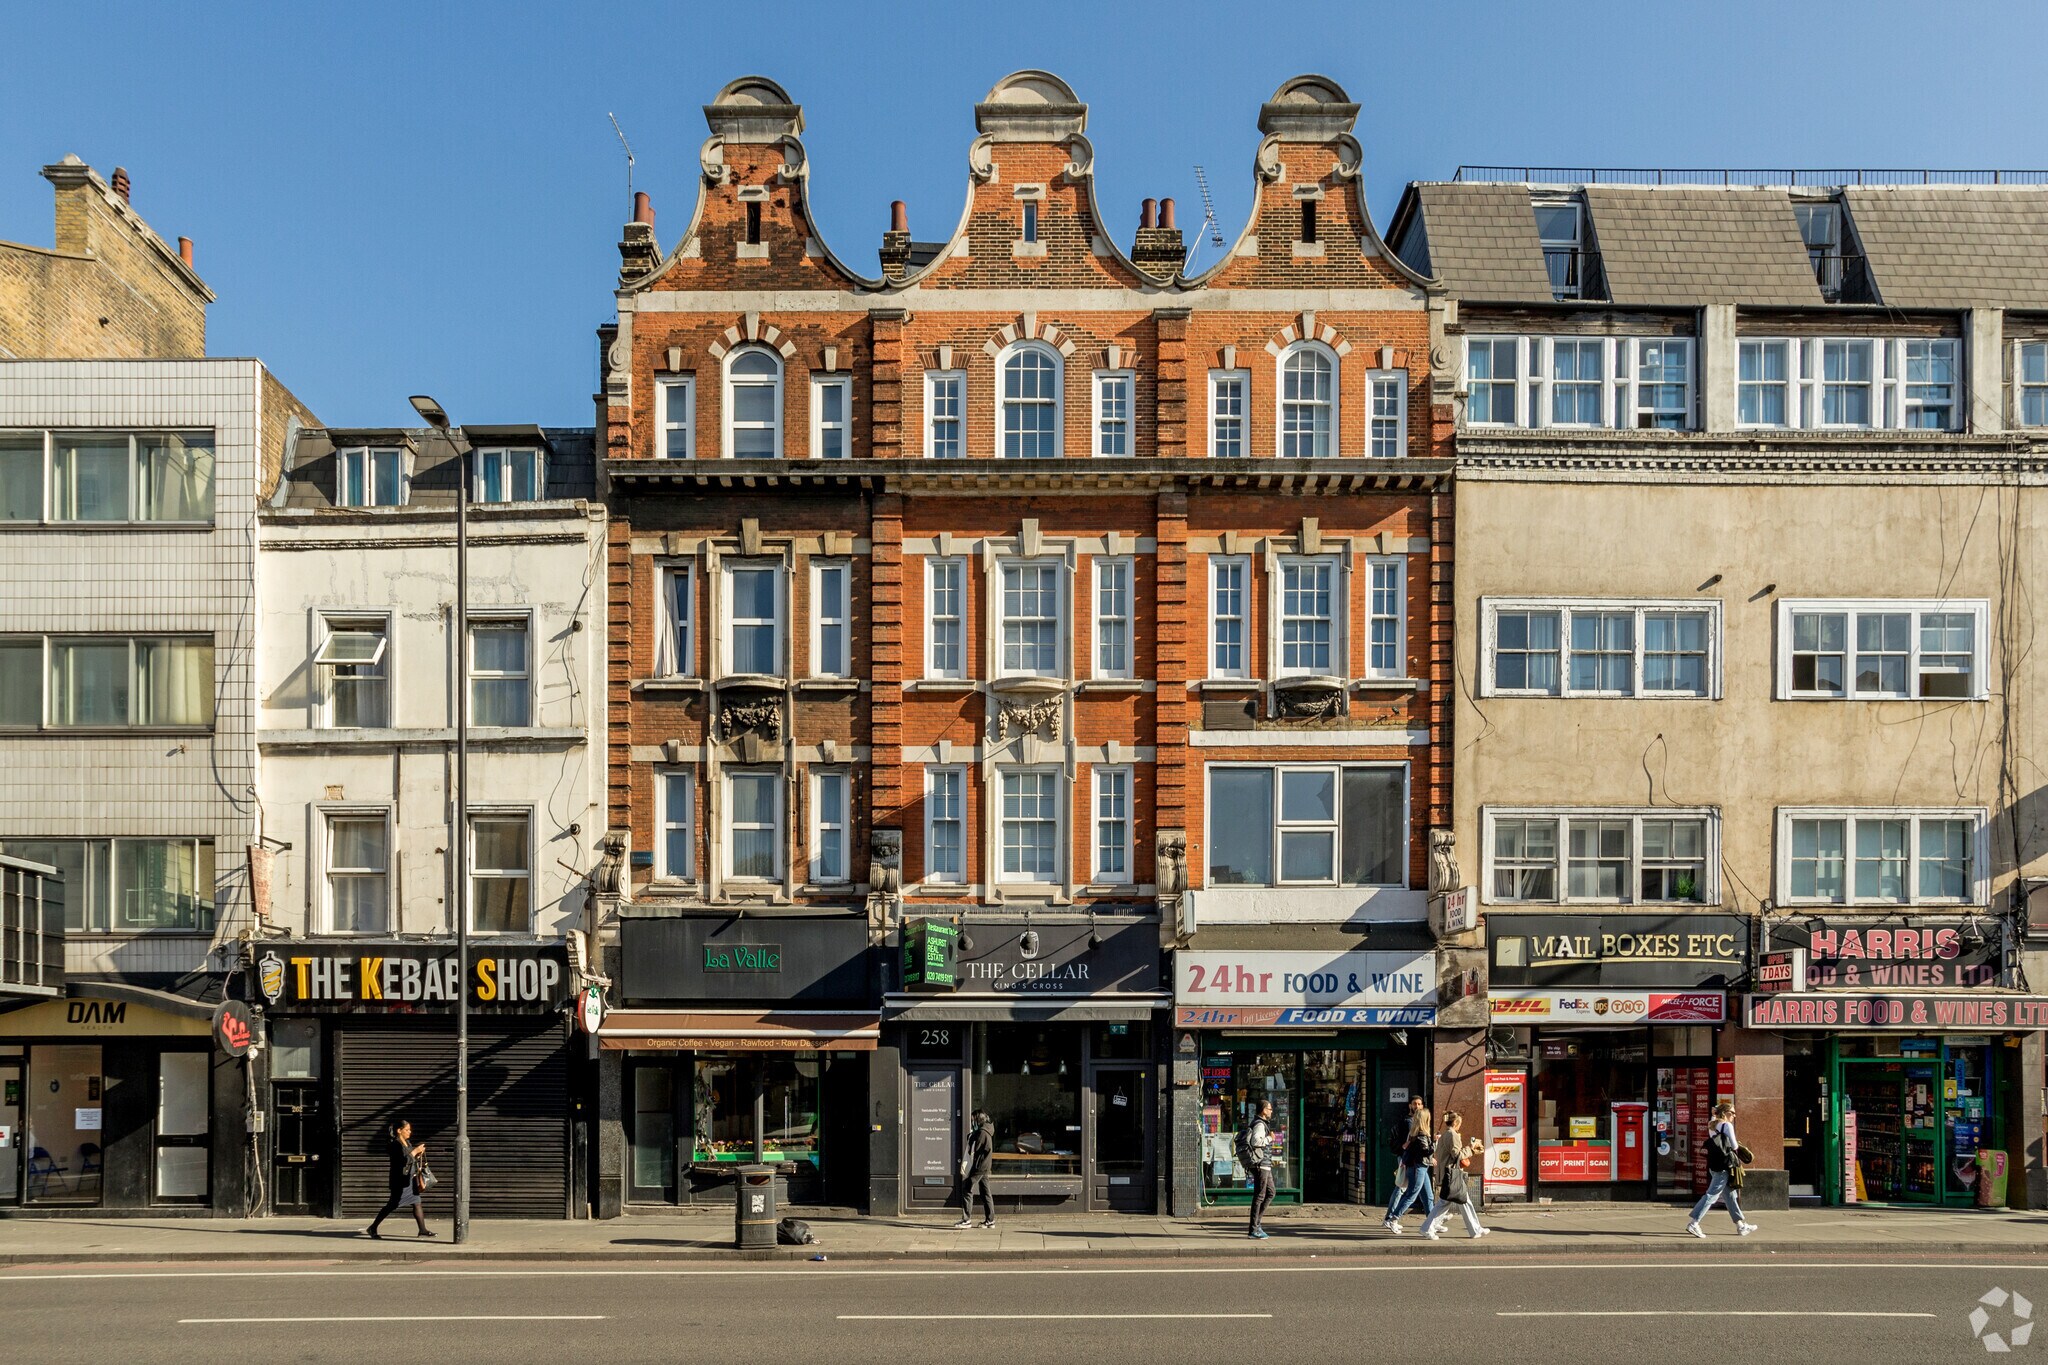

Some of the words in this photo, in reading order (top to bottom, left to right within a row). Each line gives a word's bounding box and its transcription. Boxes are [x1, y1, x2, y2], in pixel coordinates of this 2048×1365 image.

[1448, 895, 1454, 910] 24
[1457, 893, 1465, 906] hr
[927, 937, 947, 947] ASHURST
[927, 945, 939, 953] REAL
[1532, 935, 1597, 957] MAIL
[1601, 934, 1680, 956] BOXES
[1811, 929, 1961, 959] HARRIS
[705, 948, 730, 968] La
[733, 946, 780, 968] Valle
[927, 953, 944, 962] ESTATE
[966, 963, 1004, 979] THE
[1011, 963, 1090, 979] CELLAR
[1762, 968, 1768, 979] 7
[1768, 966, 1790, 979] DAYS
[1844, 965, 1861, 985] &
[1870, 965, 1945, 985] WINES
[1954, 965, 1994, 985] LTD
[291, 957, 353, 999] THE
[361, 957, 459, 1000] KEBAB
[476, 958, 559, 1000] SHOP
[1187, 965, 1273, 993] 24hr
[1283, 973, 1338, 993] FOOD
[1346, 973, 1364, 993] &
[1371, 973, 1424, 993] WINE
[1492, 1000, 1546, 1012] DHL
[1559, 999, 1590, 1009] FedEx
[1612, 1001, 1644, 1012] TNT
[1688, 997, 1719, 1007] FORCE
[67, 1002, 127, 1023] DAM
[1182, 1010, 1238, 1023] 24hr
[1288, 1010, 1347, 1022] FOOD
[1352, 1010, 1368, 1022] &
[1376, 1010, 1431, 1022] WINE
[1755, 1000, 1838, 1024] HARRIS
[1844, 1000, 1904, 1024] FOOD
[1911, 1000, 1928, 1024] &
[1934, 1001, 2008, 1025] WINES
[2014, 1002, 2048, 1025] LTD
[647, 1038, 677, 1048] Organic
[678, 1038, 703, 1047] Coffee
[709, 1038, 734, 1048] Vegan
[741, 1039, 774, 1047] Rawfood
[781, 1039, 798, 1047] Raw
[800, 1039, 829, 1047] Dessert
[920, 1029, 950, 1045] 258
[1490, 1099, 1517, 1109] FedEx
